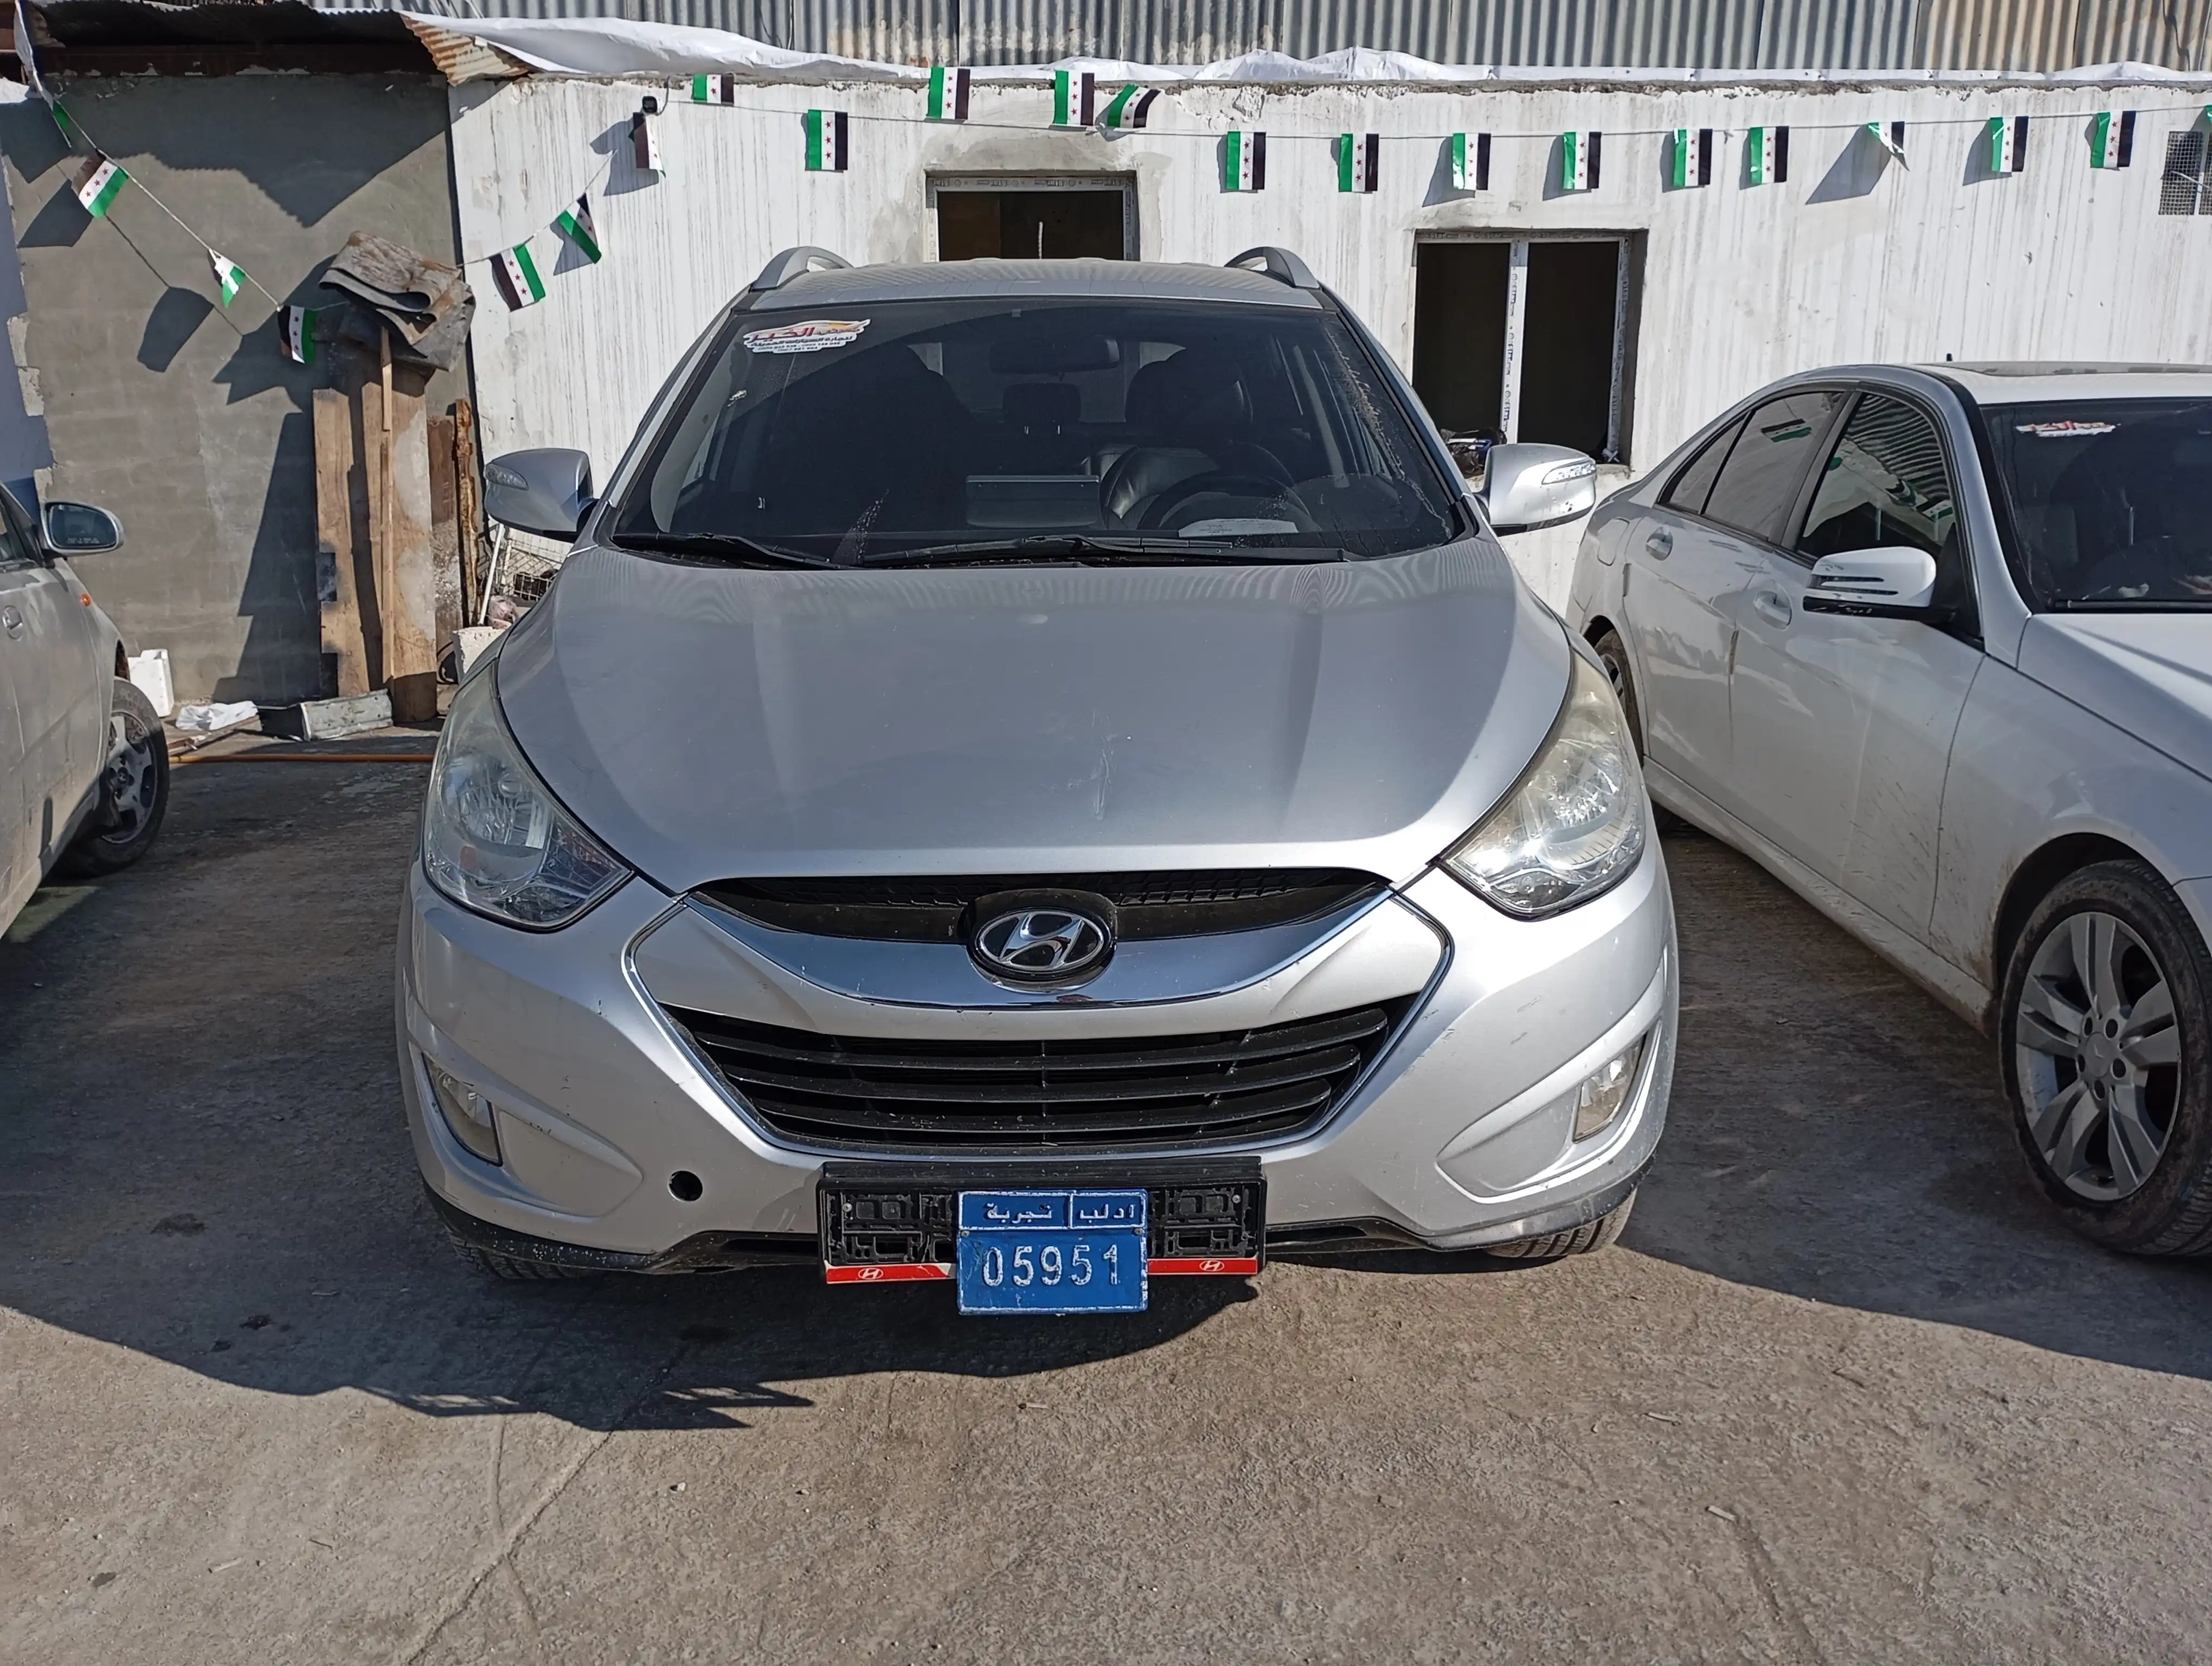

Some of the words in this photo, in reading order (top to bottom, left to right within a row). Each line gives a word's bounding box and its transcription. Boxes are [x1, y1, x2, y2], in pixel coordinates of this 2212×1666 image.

[986, 1202, 1052, 1223] تجربة
[1079, 1203, 1136, 1223] ادلب
[983, 1244, 1118, 1287] 05951
